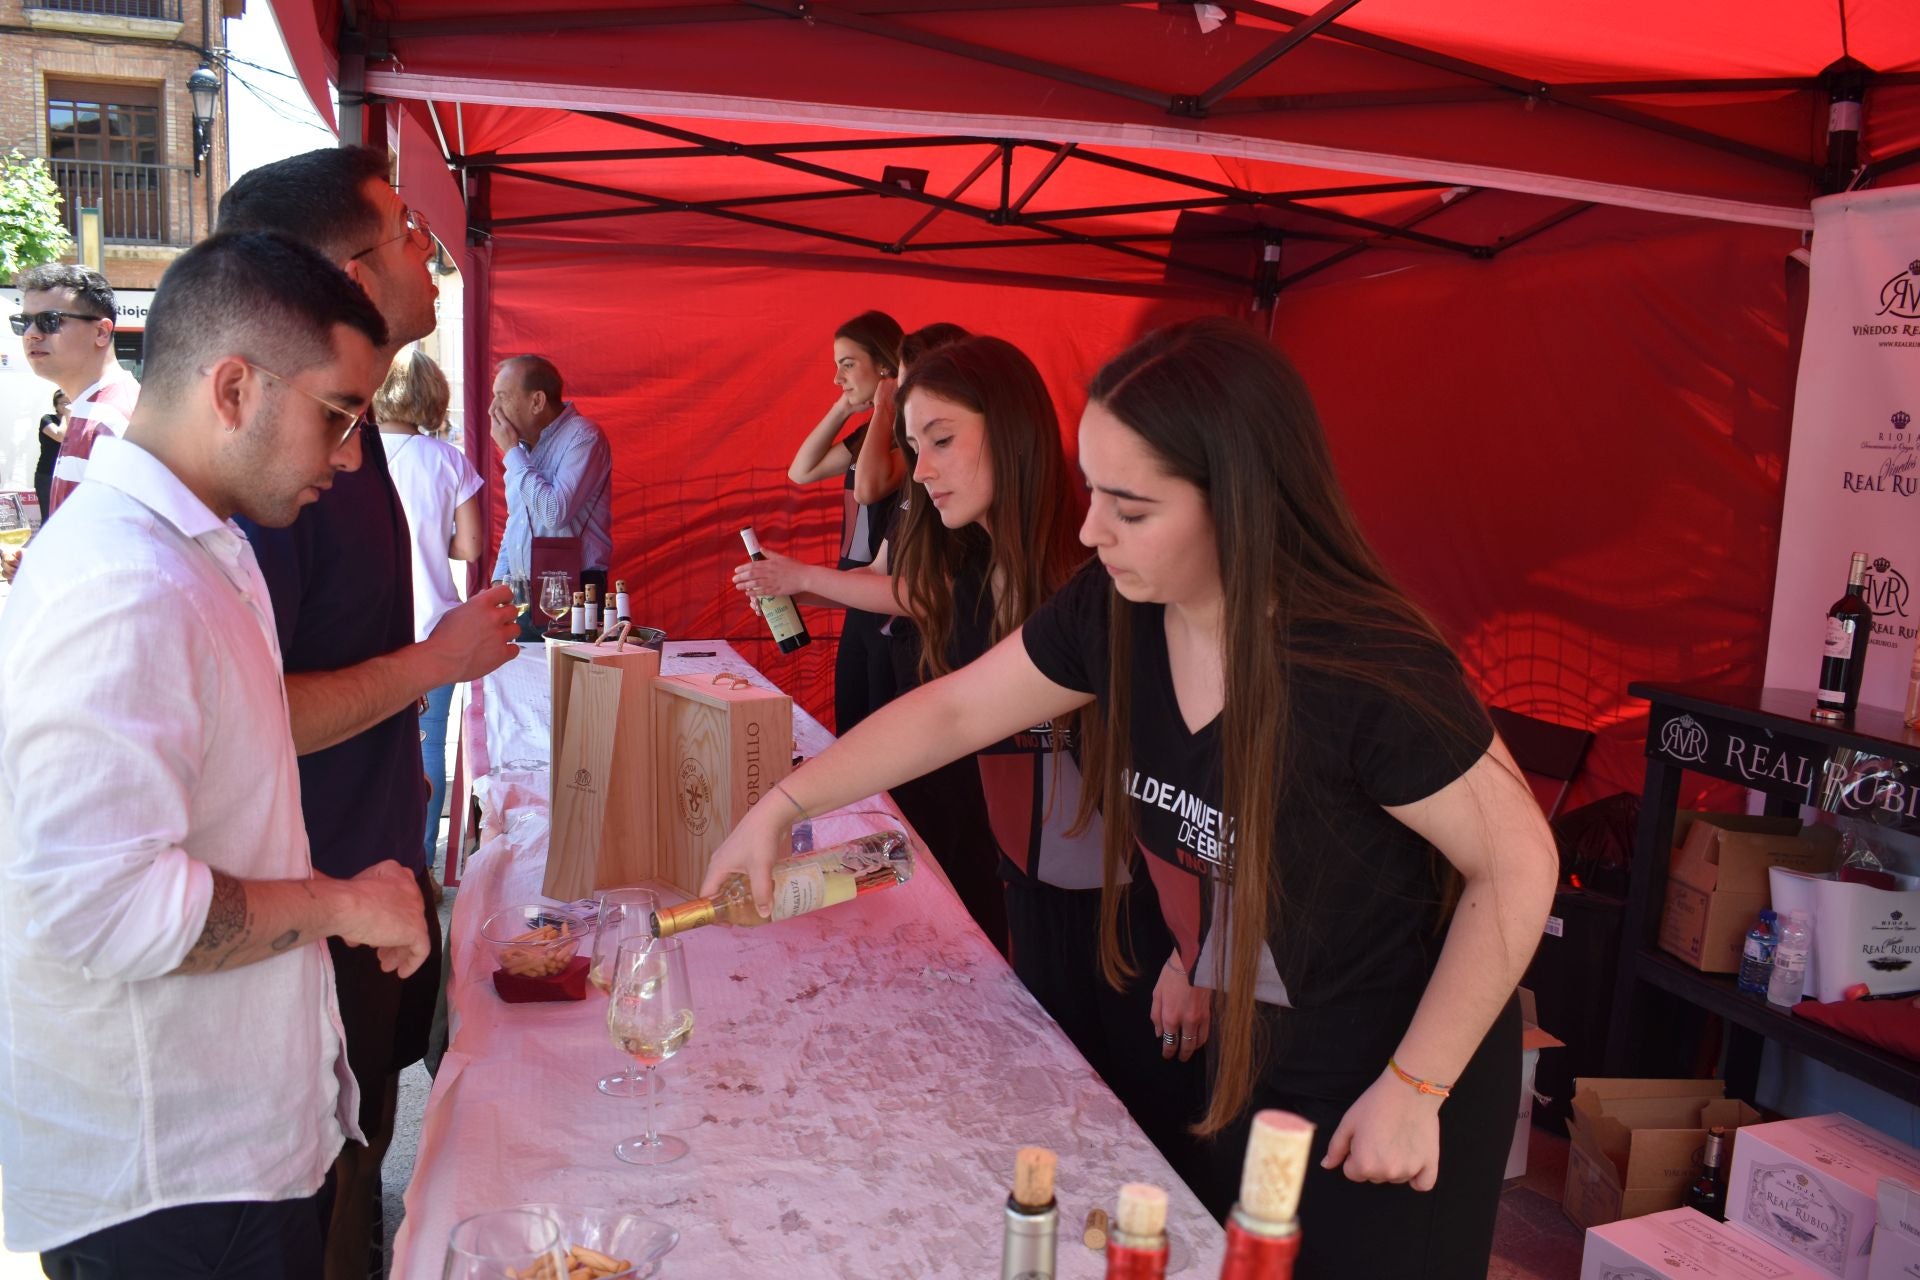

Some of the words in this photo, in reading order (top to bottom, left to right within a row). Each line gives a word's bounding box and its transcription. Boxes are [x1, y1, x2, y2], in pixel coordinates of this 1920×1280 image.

[1852, 324, 1898, 336] VIÑEDOS
[1902, 324, 1920, 336] RE
[1843, 471, 1885, 493] REAL
[1871, 621, 1895, 635] REAL
[746, 722, 761, 812] ORDILLO
[1723, 734, 1813, 789] REAL
[1862, 944, 1886, 955] REAL
[1766, 1191, 1790, 1213] REAL
[1795, 1207, 1829, 1233] RUBIO
